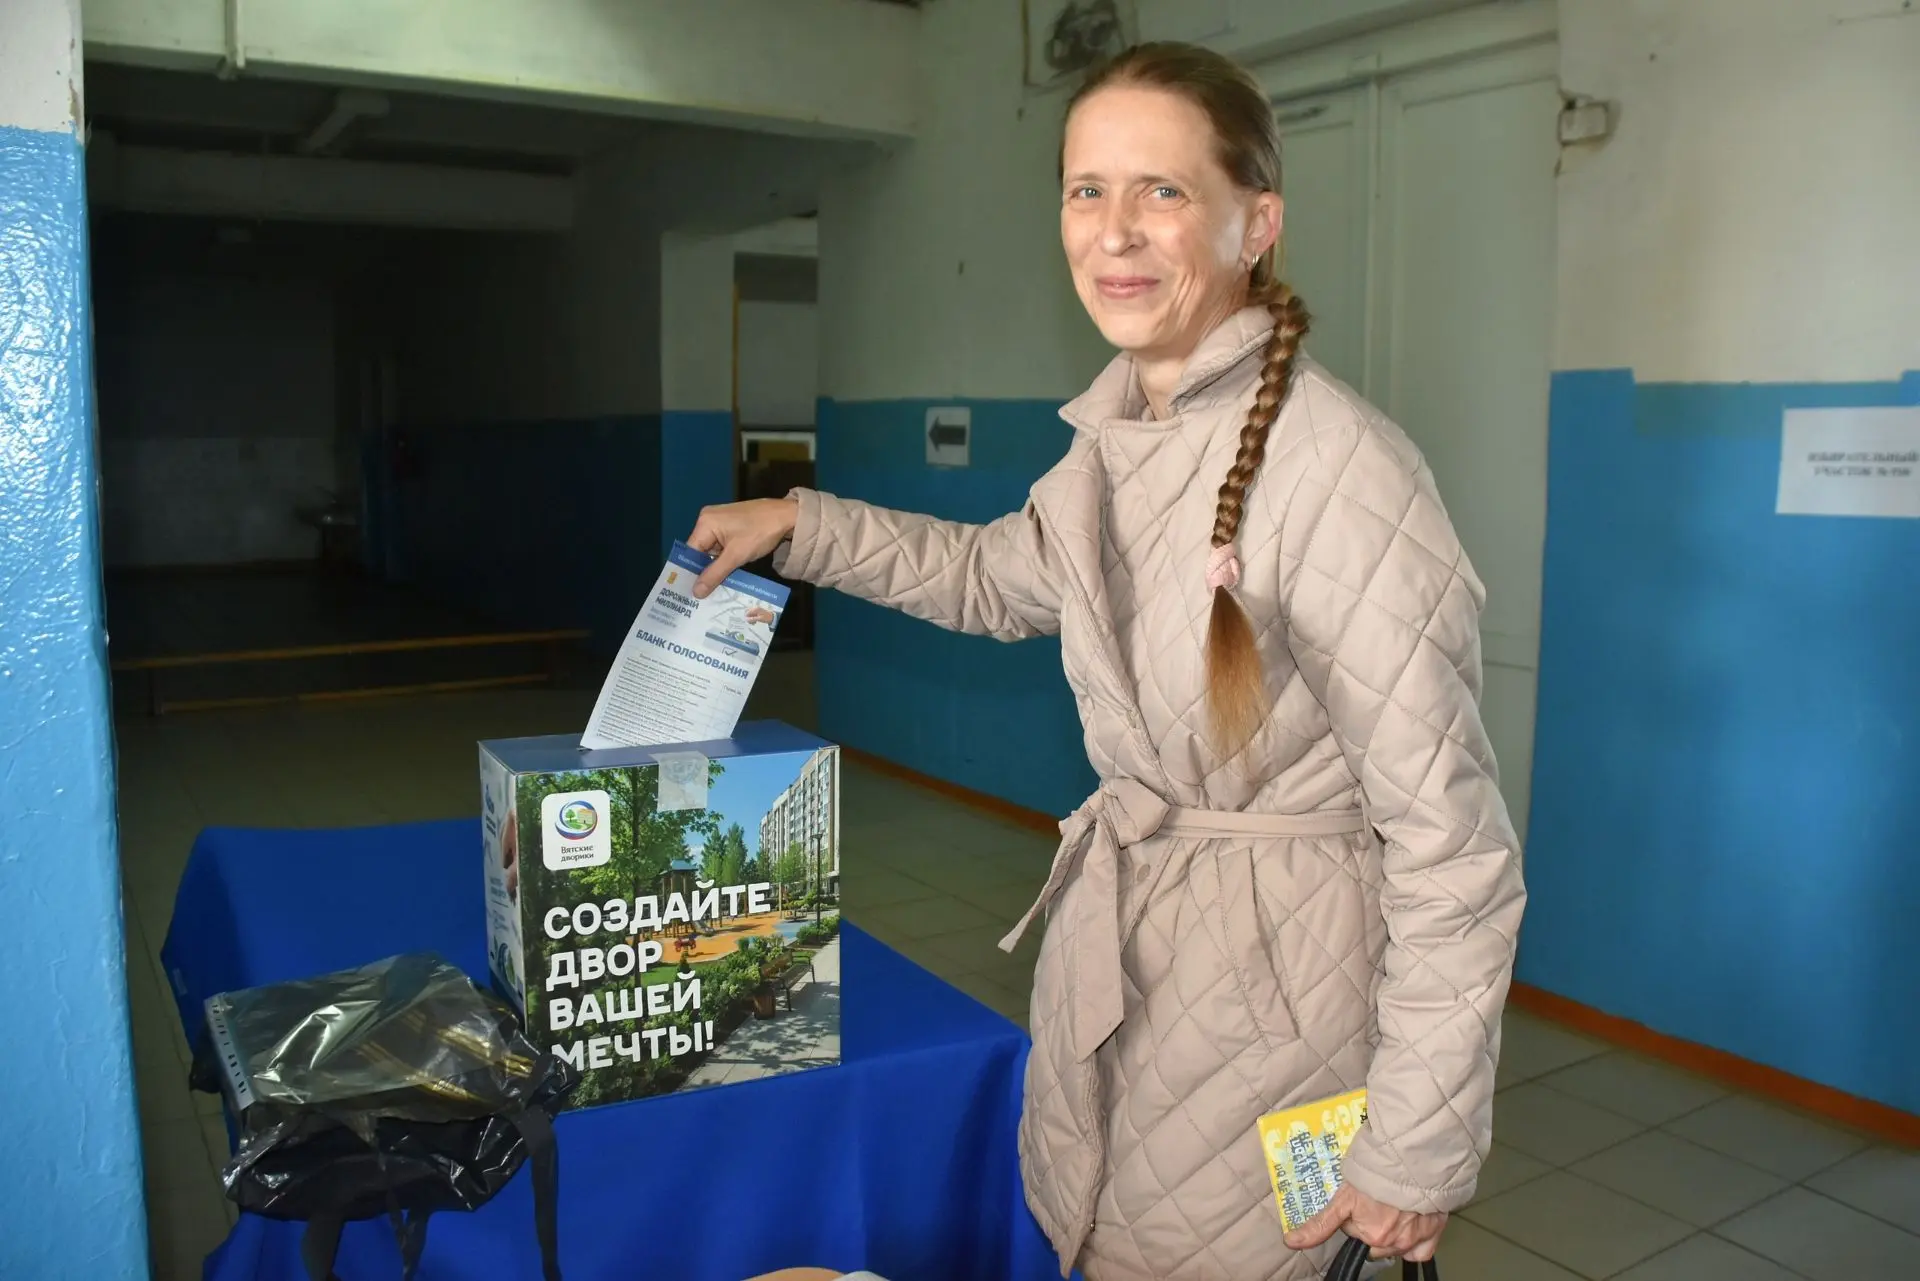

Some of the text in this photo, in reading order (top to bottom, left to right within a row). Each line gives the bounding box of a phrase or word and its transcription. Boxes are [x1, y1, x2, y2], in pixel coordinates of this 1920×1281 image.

[655, 596, 692, 619] МИЛЛИАРД
[659, 587, 700, 610] ДОРОЖНЫЙ
[635, 628, 749, 680] БЛАНК ГОЛОСОВАНИЯ
[561, 844, 594, 854] Вятские
[561, 852, 594, 862] дворики
[543, 879, 771, 939] СОЗДАЙТЕ
[545, 940, 663, 991] ДВОР
[549, 970, 701, 1030] ВАШЕЙ
[551, 1020, 714, 1072] МЕЧТЫ!
